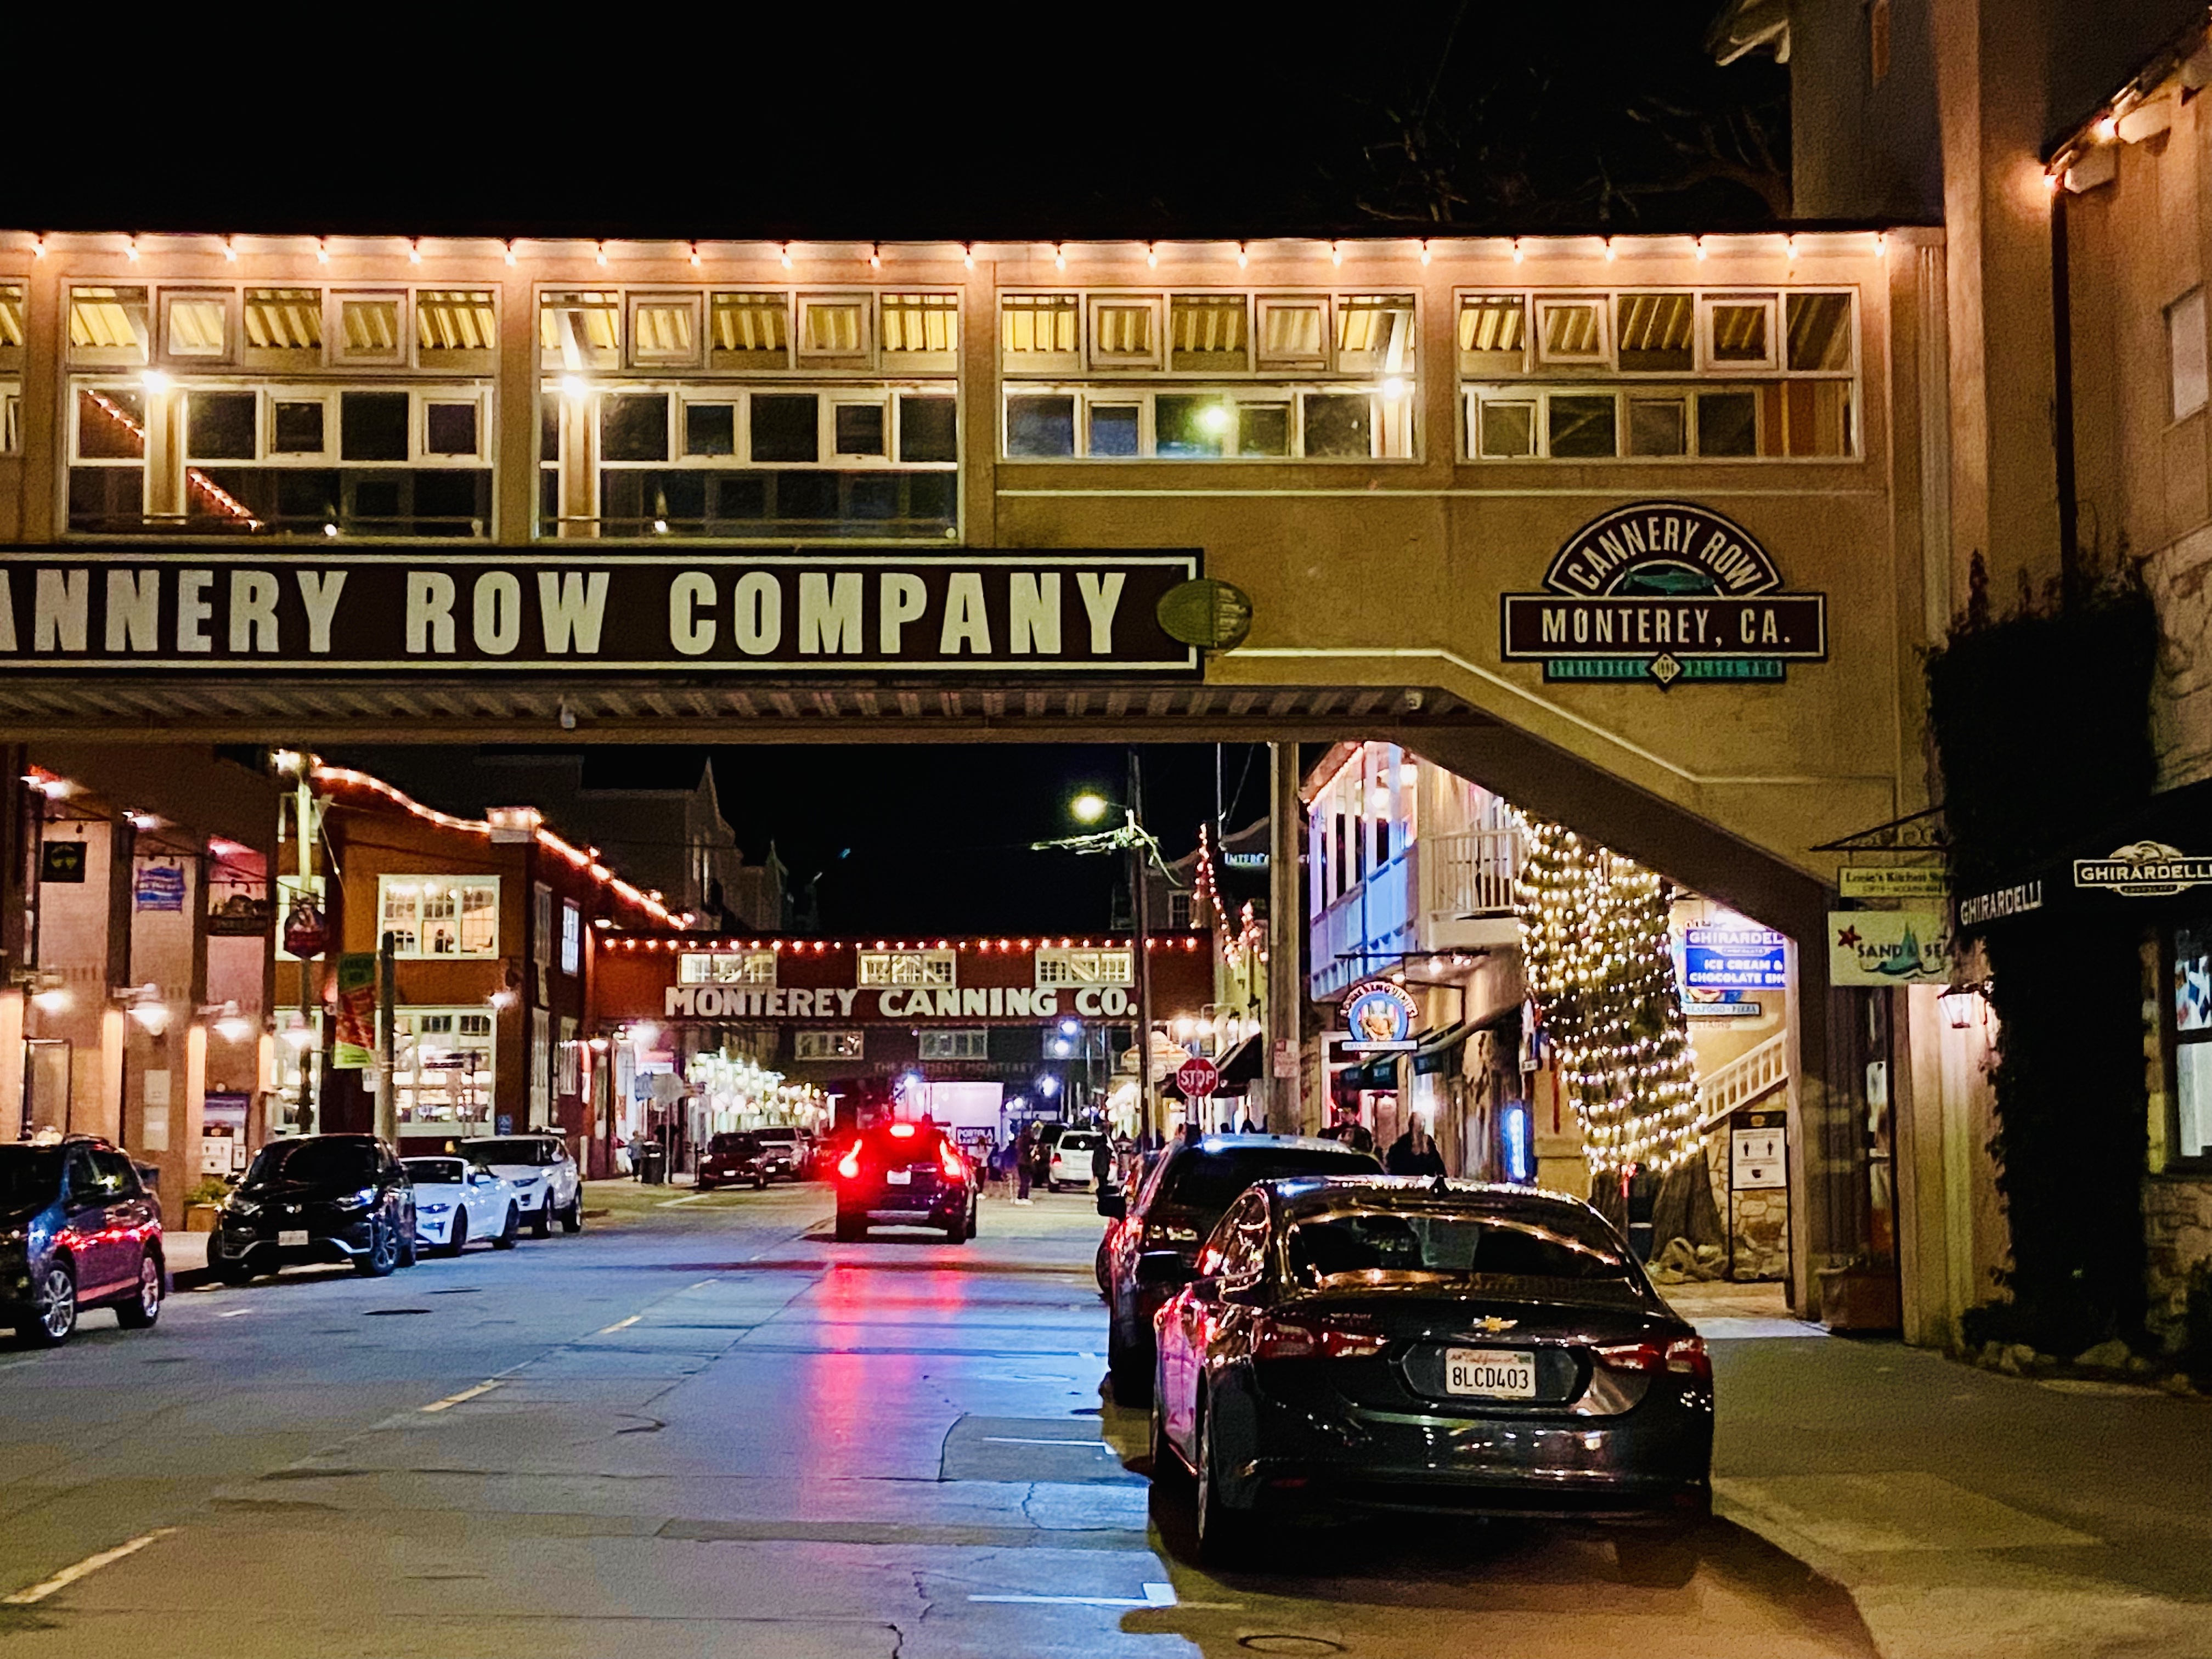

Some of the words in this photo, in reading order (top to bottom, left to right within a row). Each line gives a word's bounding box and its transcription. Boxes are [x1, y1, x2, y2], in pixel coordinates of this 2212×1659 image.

[1567, 517, 1701, 590] CANNERY
[1699, 530, 1763, 590] ROW
[407, 572, 610, 654] ROW
[670, 571, 1126, 655] COMPANY
[1542, 607, 1723, 647] MONTEREY,
[1741, 608, 1791, 644] CA.
[2081, 864, 2212, 881] GHIRARDELLI
[1960, 879, 2042, 927] GHIRARDELLI
[1689, 932, 1784, 944] GHIRARDEL
[1858, 943, 1903, 958] SAND
[1704, 959, 1724, 970] ICE
[1727, 959, 1771, 970] CREAM
[1689, 972, 1762, 983] CHOCOLATE
[664, 987, 857, 1017] MONTEREY
[878, 988, 1058, 1017] CANNING
[1075, 987, 1138, 1017] CO.
[1180, 1070, 1215, 1086] STOP
[1453, 1367, 1528, 1389] 8LCD403
